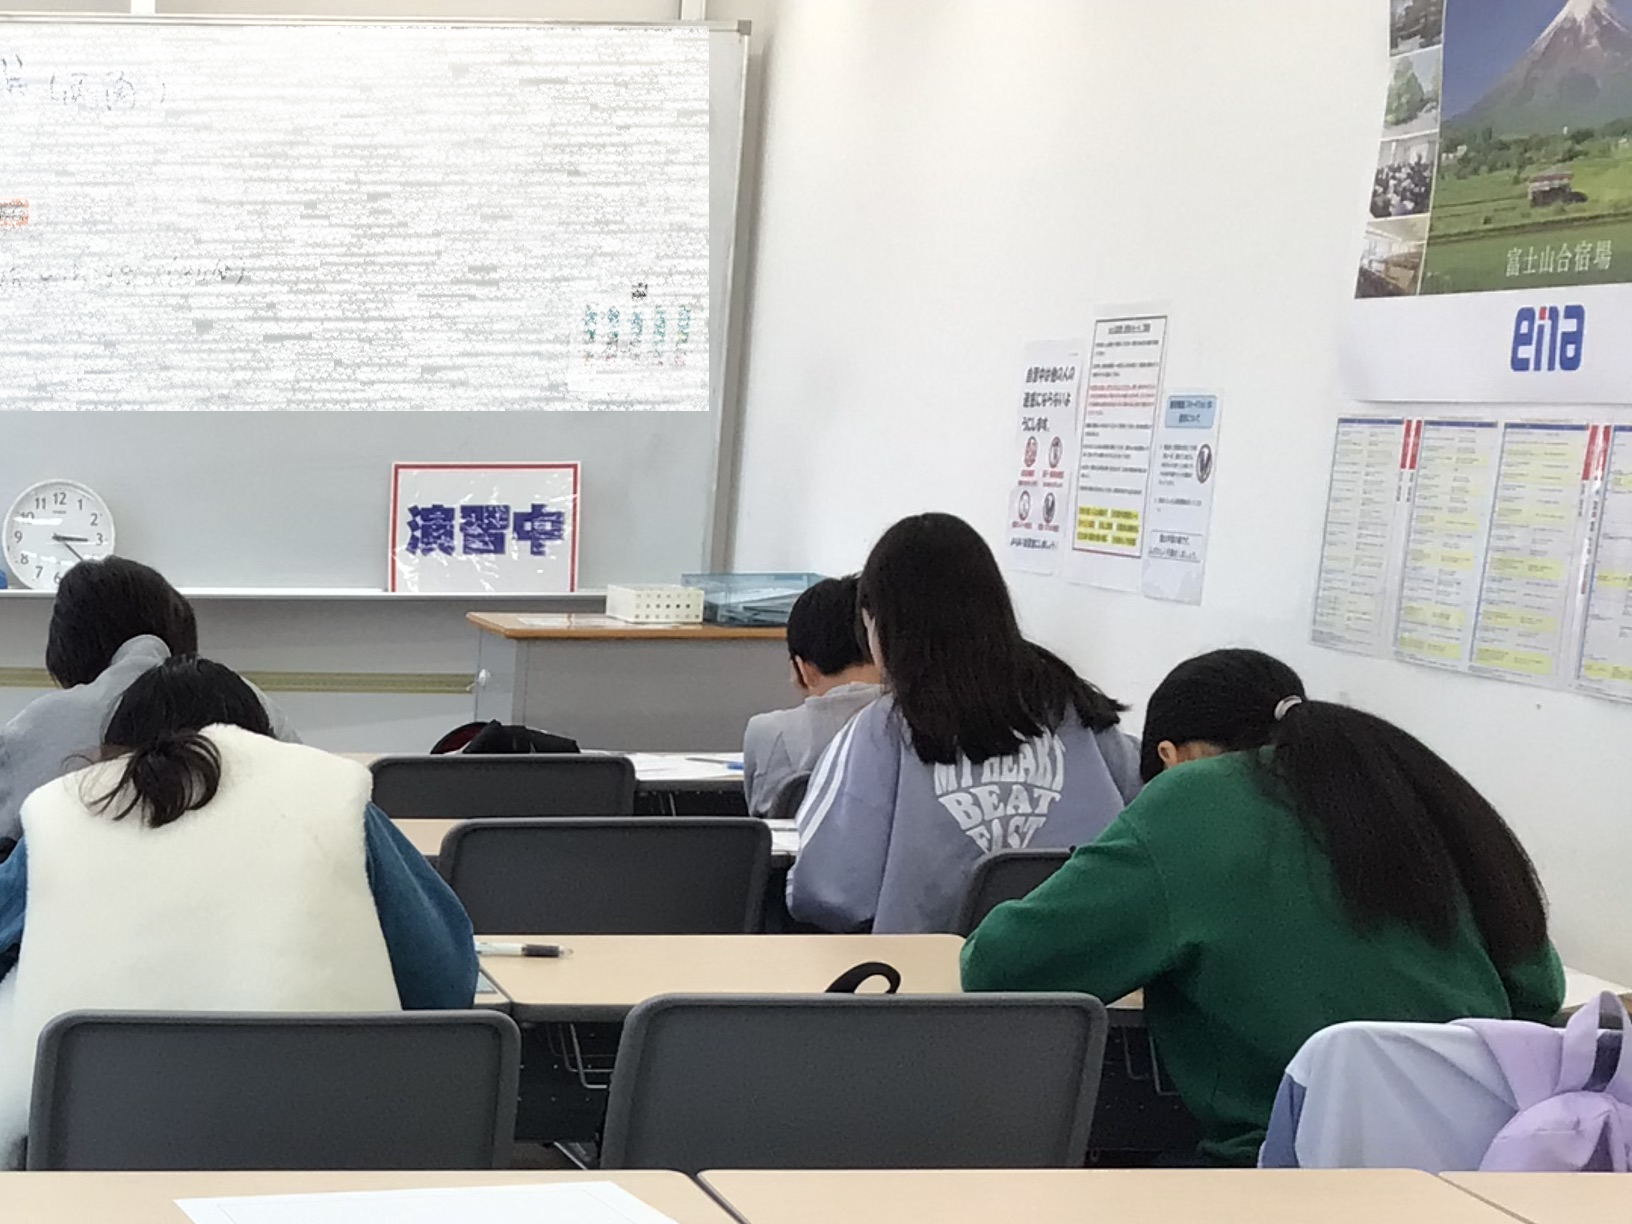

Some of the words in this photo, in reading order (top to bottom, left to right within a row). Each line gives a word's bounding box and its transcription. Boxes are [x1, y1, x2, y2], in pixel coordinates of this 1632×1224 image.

[1506, 240, 1612, 277] 富士山合宿場
[35, 497, 46, 509] 11
[53, 492, 66, 505] 12
[78, 499, 84, 510] 1
[90, 513, 98, 525] 2
[14, 530, 22, 542] 9
[405, 503, 565, 557] 演習中
[96, 533, 103, 545] 3
[20, 552, 28, 564] 8
[35, 566, 43, 578] 7
[938, 784, 1062, 831] BEAT
